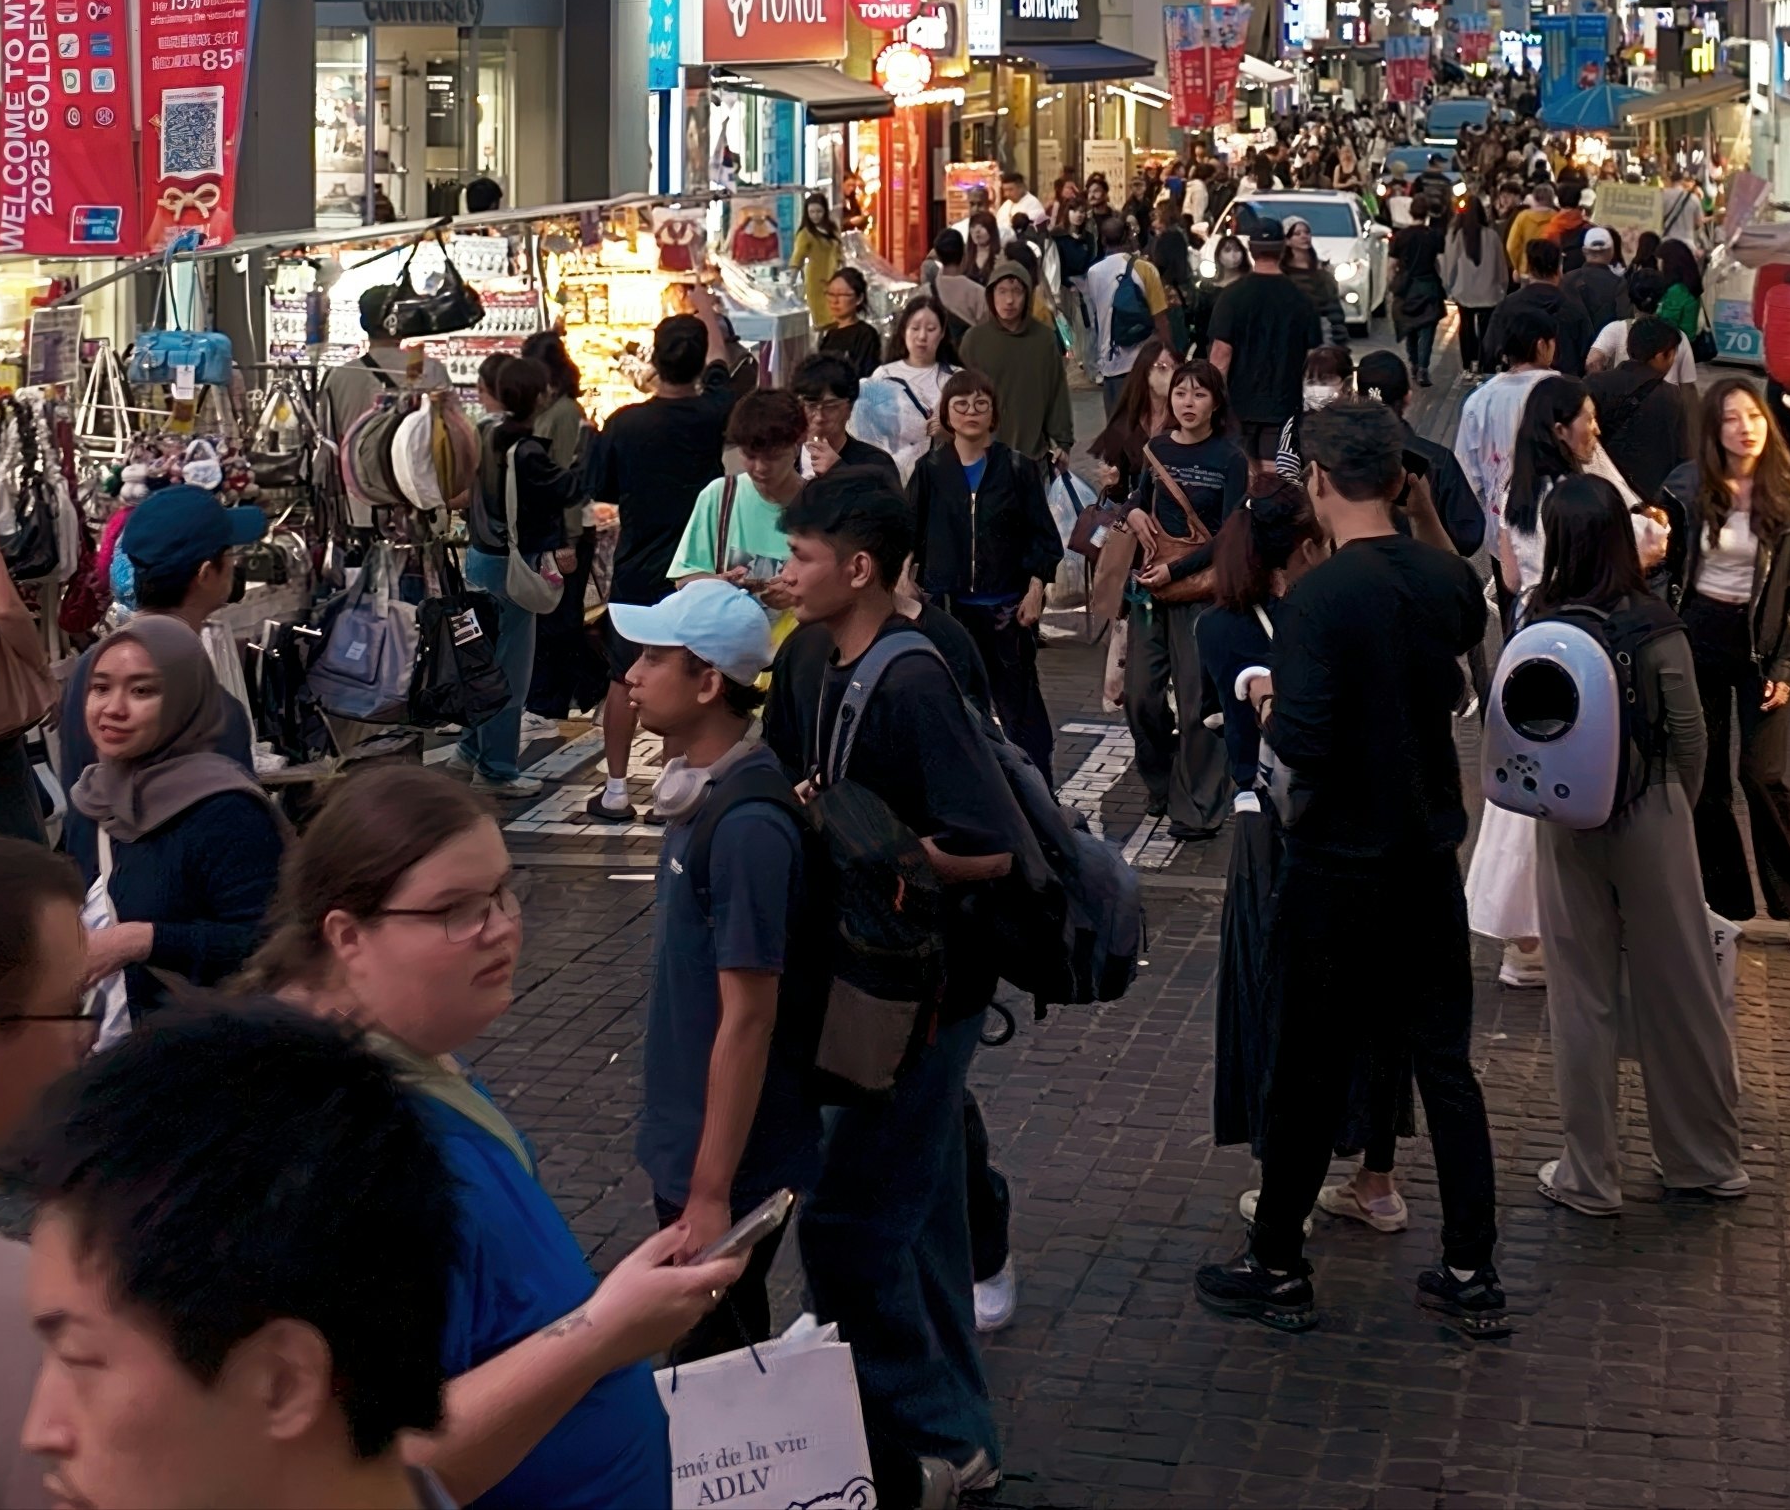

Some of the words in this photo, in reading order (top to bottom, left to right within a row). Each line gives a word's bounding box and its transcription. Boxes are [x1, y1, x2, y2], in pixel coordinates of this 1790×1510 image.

[858, 3, 912, 19] TONUE
[4, 38, 25, 84] TO
[29, 139, 53, 216] 2025
[1723, 331, 1752, 352] 70
[697, 1465, 771, 1507] ADLV
